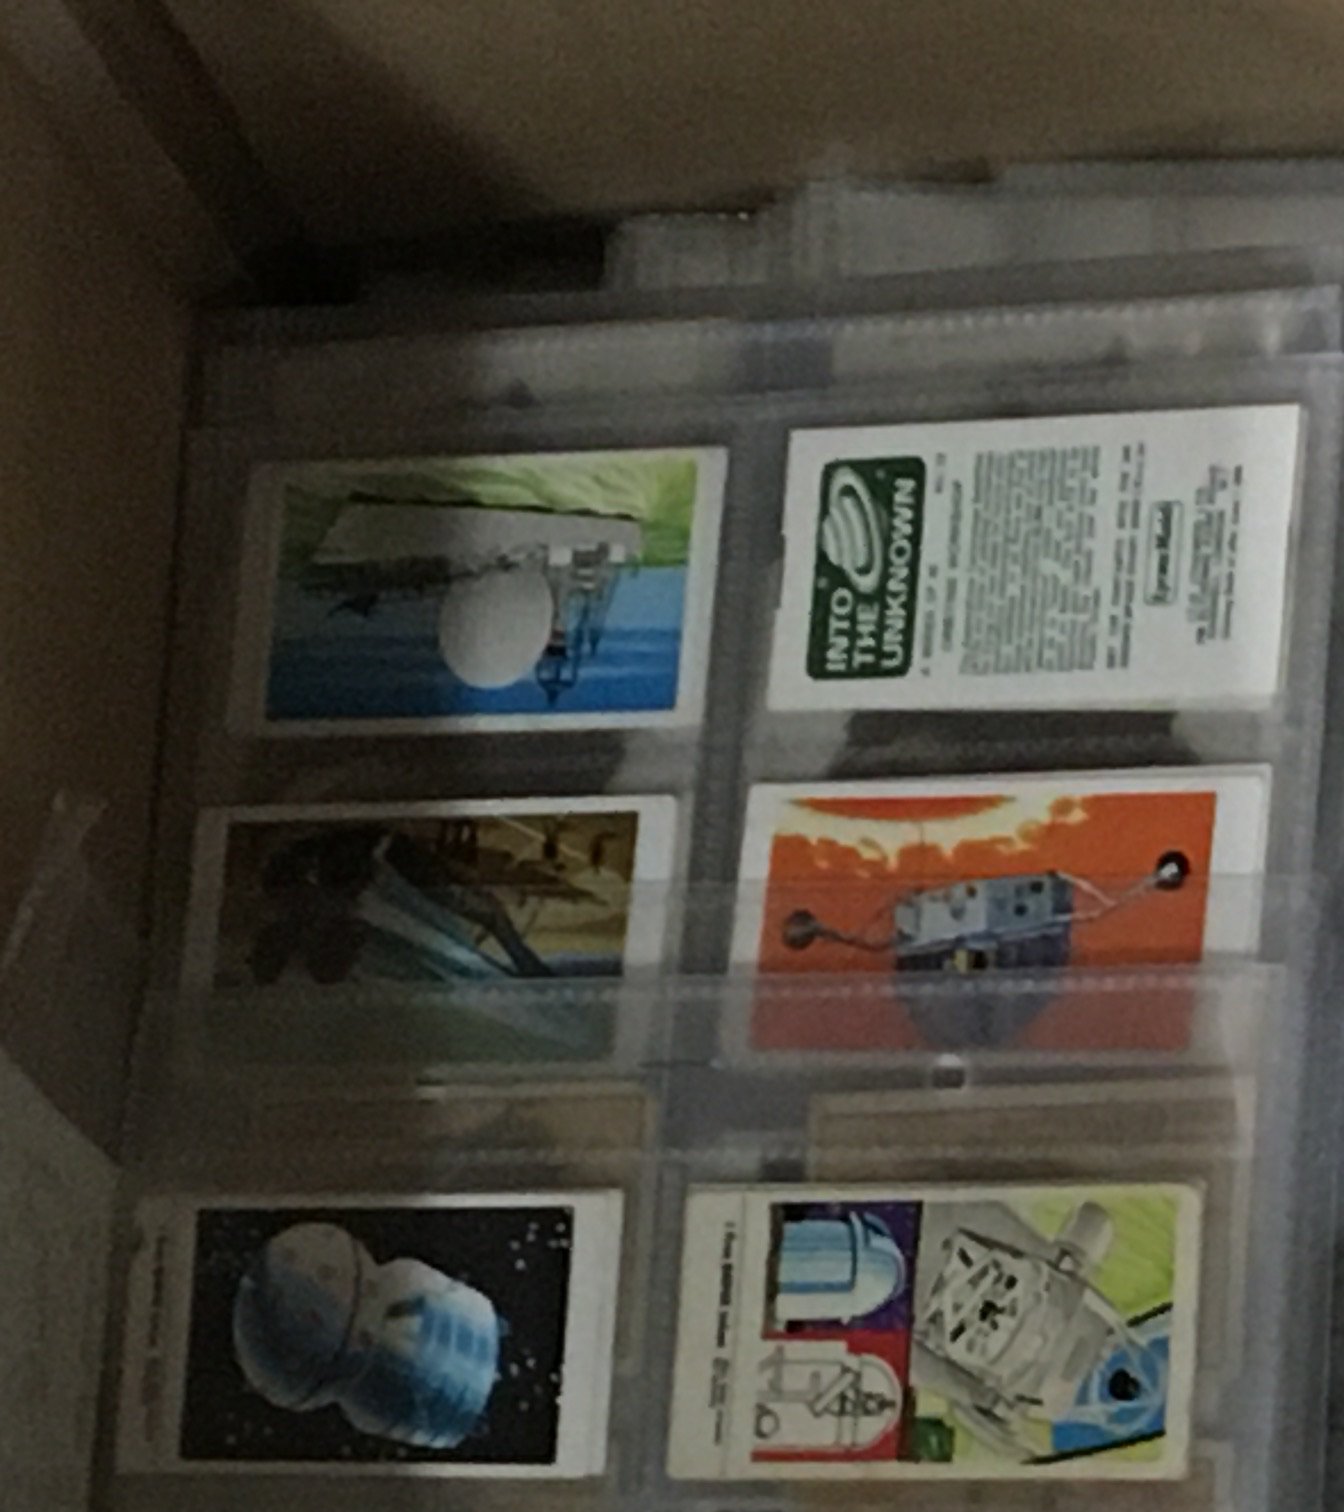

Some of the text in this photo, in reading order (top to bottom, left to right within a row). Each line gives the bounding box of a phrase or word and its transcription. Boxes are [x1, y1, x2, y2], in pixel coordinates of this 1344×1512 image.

[880, 476, 917, 669] UNKNOWN
[825, 586, 854, 672] INTO
[852, 601, 880, 669] THE
